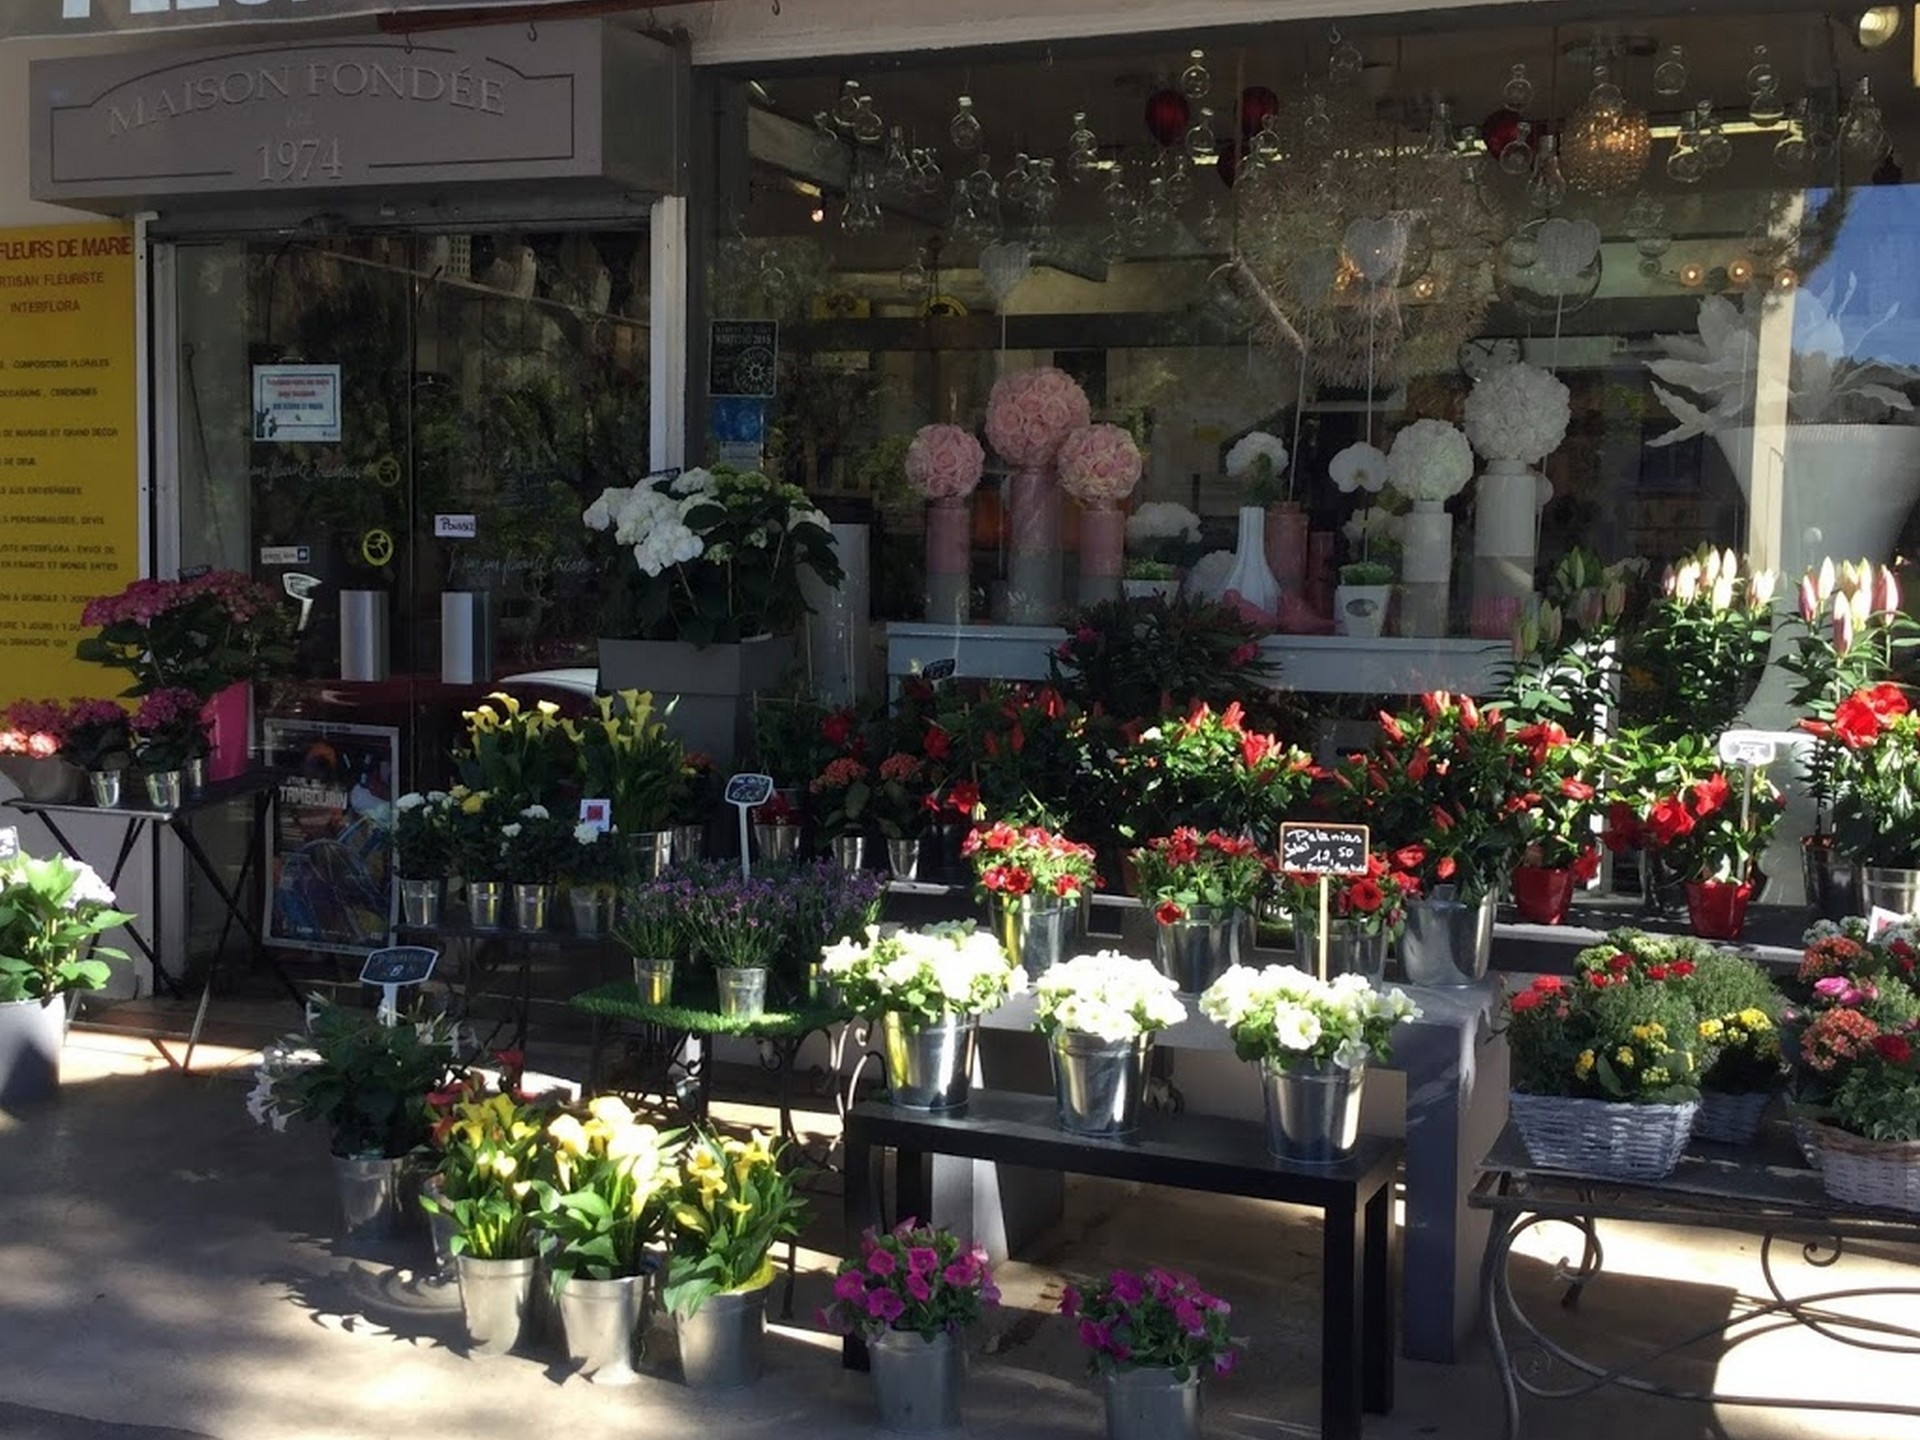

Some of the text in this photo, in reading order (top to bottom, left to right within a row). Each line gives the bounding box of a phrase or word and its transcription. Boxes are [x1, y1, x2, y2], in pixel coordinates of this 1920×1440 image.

[107, 61, 505, 137] MAISON FONDÉE
[255, 137, 344, 183] 1974
[57, 239, 78, 258] DE
[43, 271, 104, 286] FLEURISTE
[10, 299, 81, 313] INTERFLORA
[21, 544, 70, 554] INTERFLORA
